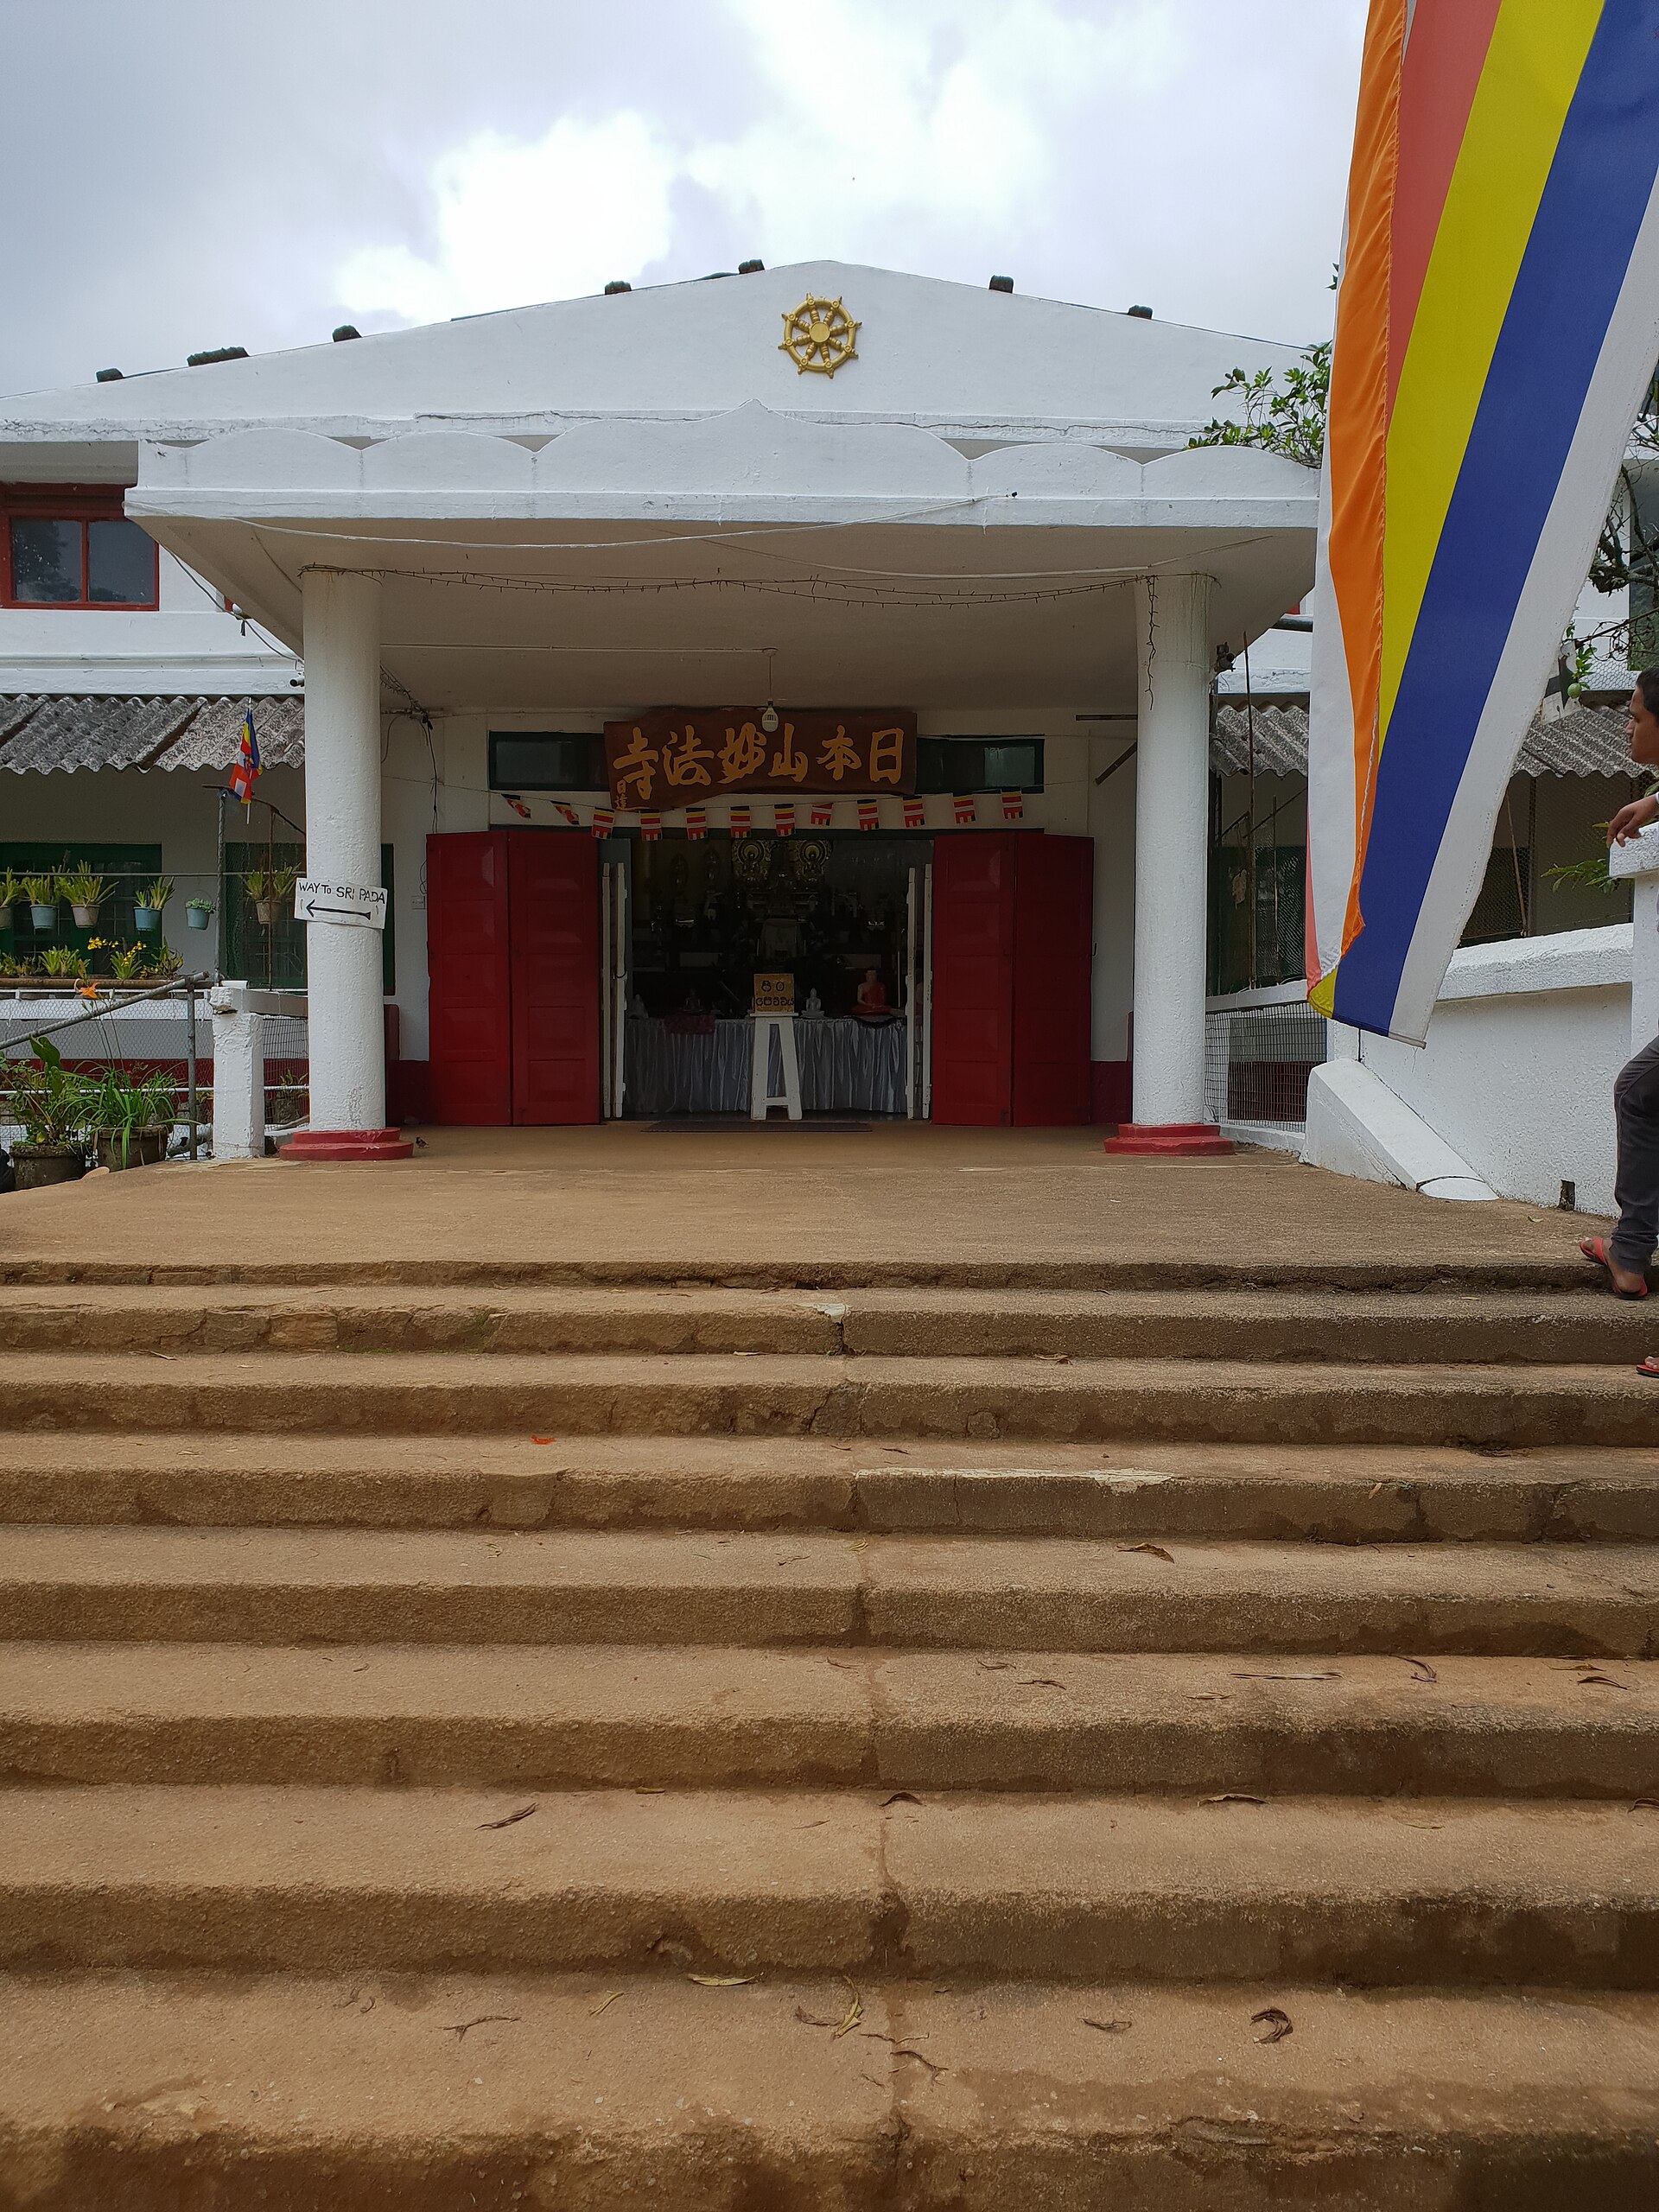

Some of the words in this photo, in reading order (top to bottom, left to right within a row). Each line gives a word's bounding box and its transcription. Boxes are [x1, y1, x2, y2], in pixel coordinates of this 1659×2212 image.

[299, 881, 321, 894] WAY
[336, 887, 355, 900] SRI
[359, 888, 385, 905] PADA
